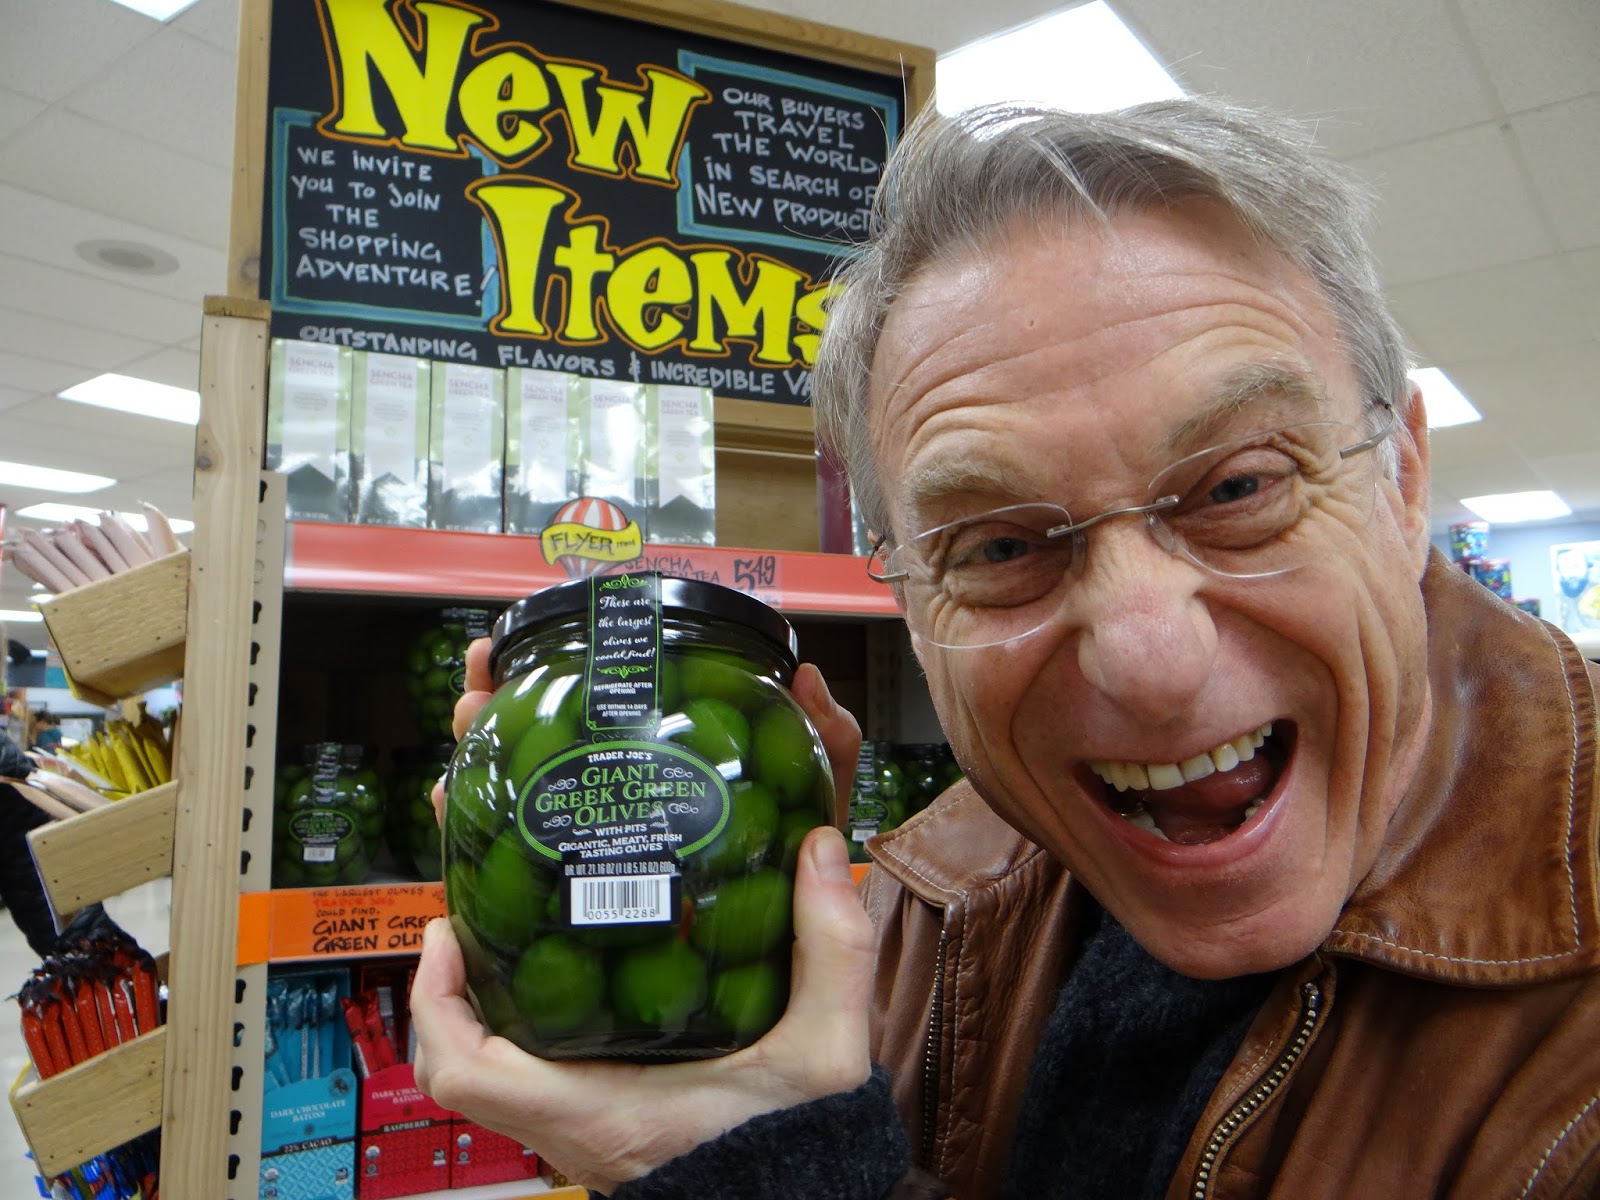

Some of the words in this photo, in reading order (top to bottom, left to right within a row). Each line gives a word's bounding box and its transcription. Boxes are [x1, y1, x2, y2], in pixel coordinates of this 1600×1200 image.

[723, 88, 773, 111] OUR
[781, 98, 864, 130] BUYERS
[734, 111, 854, 149] TRAVEL
[712, 133, 770, 155] THE
[785, 141, 878, 173] WORLD
[297, 146, 336, 166] WE
[353, 150, 432, 182] INVITE
[704, 156, 732, 181] IN
[750, 166, 839, 197] SEARCH
[388, 183, 440, 211] JOIN
[695, 183, 762, 218] NEW
[773, 198, 875, 232] PRODUCT
[326, 204, 379, 228] THE
[299, 228, 442, 263] SHOPPING
[288, 357, 334, 369] SENCHA
[300, 325, 478, 361] OUTSTANDING
[498, 345, 615, 376] FLAVORS
[651, 361, 774, 394] INCREDIBLE
[370, 369, 413, 381] SENCHA
[449, 379, 489, 390] SENCHA
[550, 531, 614, 555] FLYER
[624, 557, 693, 572] SENCHA
[599, 595, 630, 610] These
[633, 598, 651, 607] are
[598, 616, 614, 628] the
[617, 615, 653, 630] largest
[602, 636, 632, 647] olives
[634, 636, 649, 645] we
[595, 650, 626, 661] could
[624, 647, 656, 661] find!
[593, 682, 633, 692] REFRIGERATE
[633, 681, 653, 690] AFTER
[587, 752, 624, 763] TRADER
[626, 751, 653, 761] JOE'S
[581, 763, 659, 787] GIANT
[535, 786, 615, 813] GREEK
[622, 780, 707, 802] GREEN
[574, 801, 664, 827] OLIVES
[595, 827, 623, 837] WITH
[624, 823, 647, 833] PITS
[612, 835, 649, 847] MEATY,
[651, 833, 682, 843] FRESH
[580, 847, 624, 859] TASTING
[625, 843, 663, 854] OLIVES
[606, 863, 615, 875] OZ
[623, 862, 632, 874] LB
[633, 862, 647, 874] 5.16
[387, 886, 424, 895] OLIVES
[316, 908, 345, 918] COULD
[587, 910, 618, 921] 0055
[625, 908, 656, 919] 2288
[313, 917, 379, 936] GIANT
[387, 914, 443, 930] GRE
[313, 934, 378, 953] GREEN
[387, 932, 423, 949] OLI
[372, 1090, 395, 1100] DARK
[270, 1107, 294, 1119] DARK
[383, 1119, 431, 1133] RASPBERRY
